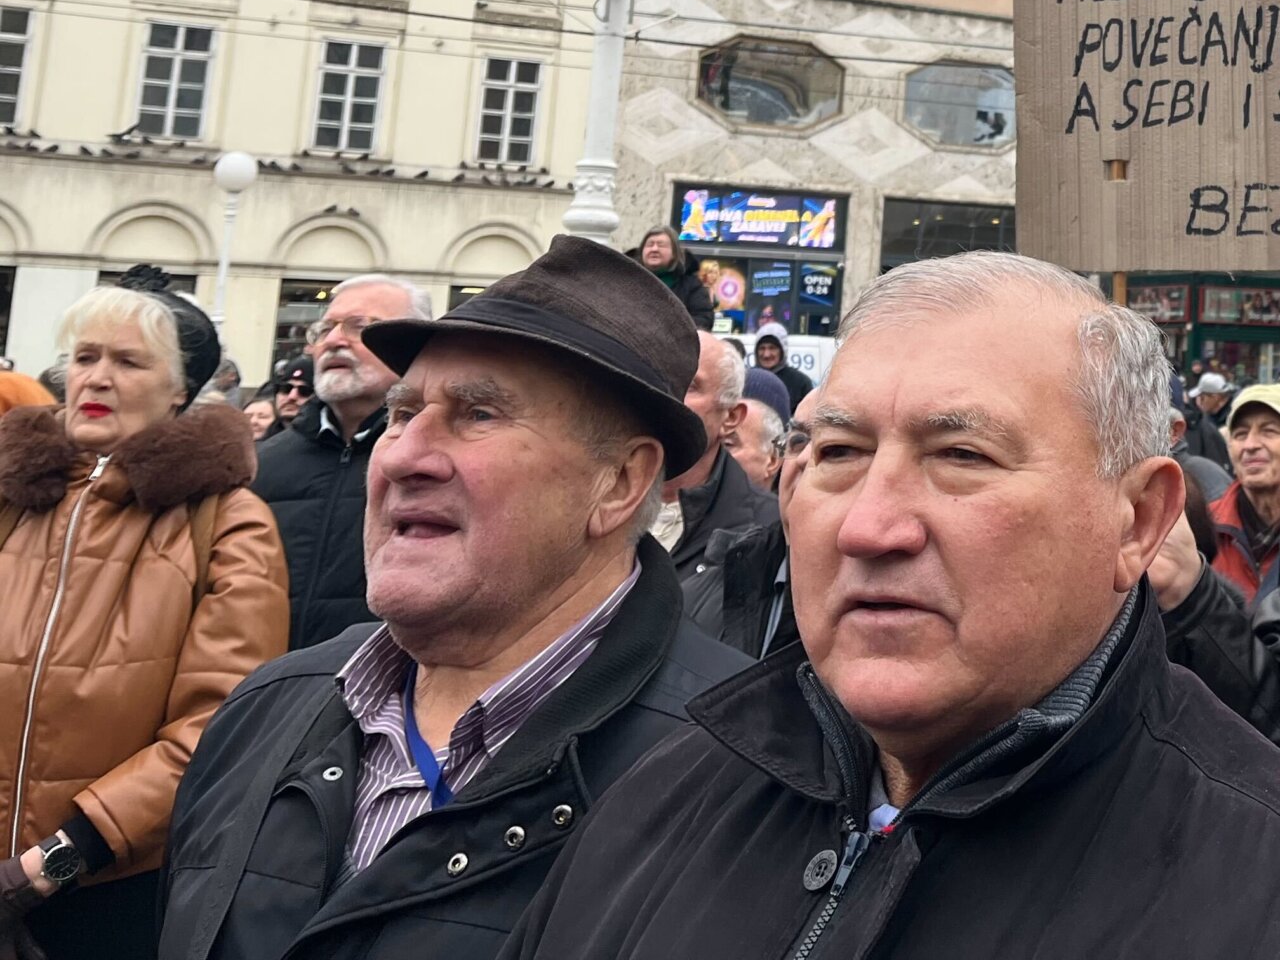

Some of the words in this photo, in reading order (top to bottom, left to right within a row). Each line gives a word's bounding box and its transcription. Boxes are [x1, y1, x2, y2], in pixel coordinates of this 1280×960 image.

[1065, 81, 1100, 134] A
[1112, 79, 1210, 131] SEBI
[1243, 83, 1252, 130] I
[804, 275, 832, 286] OPEN
[806, 285, 829, 295] 0-24
